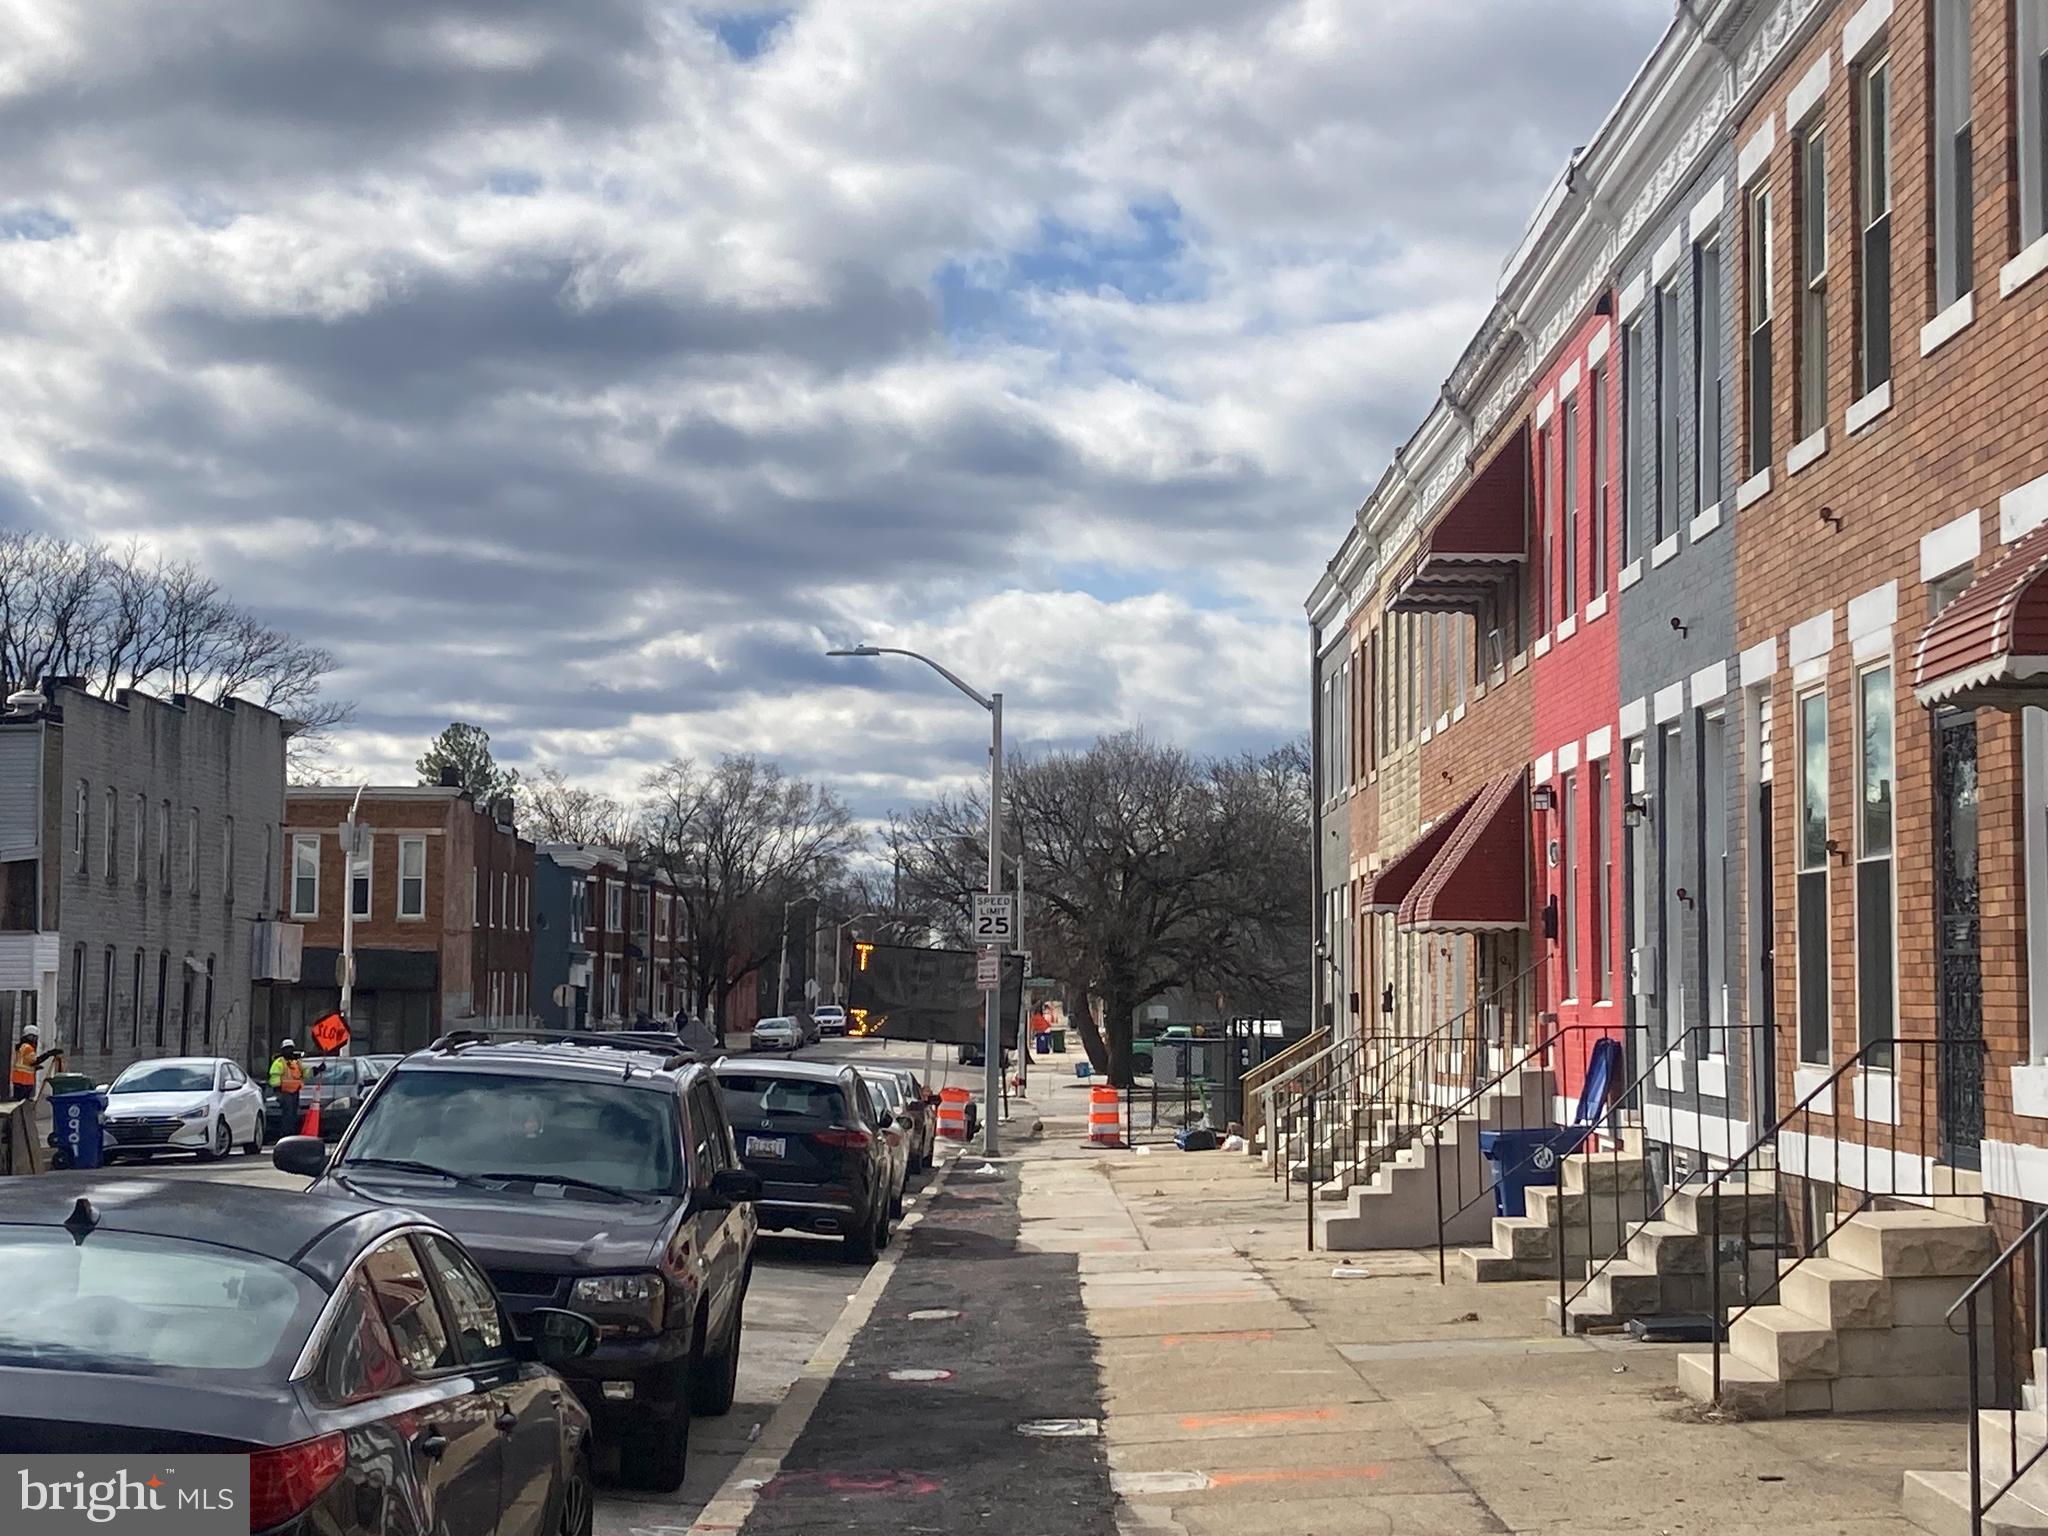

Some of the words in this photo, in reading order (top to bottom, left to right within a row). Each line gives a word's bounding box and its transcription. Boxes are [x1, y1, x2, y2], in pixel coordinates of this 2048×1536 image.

[977, 898, 1010, 906] SPEED
[980, 907, 1007, 916] LIMIT
[978, 916, 1009, 934] 25
[316, 1023, 346, 1042] SLOW
